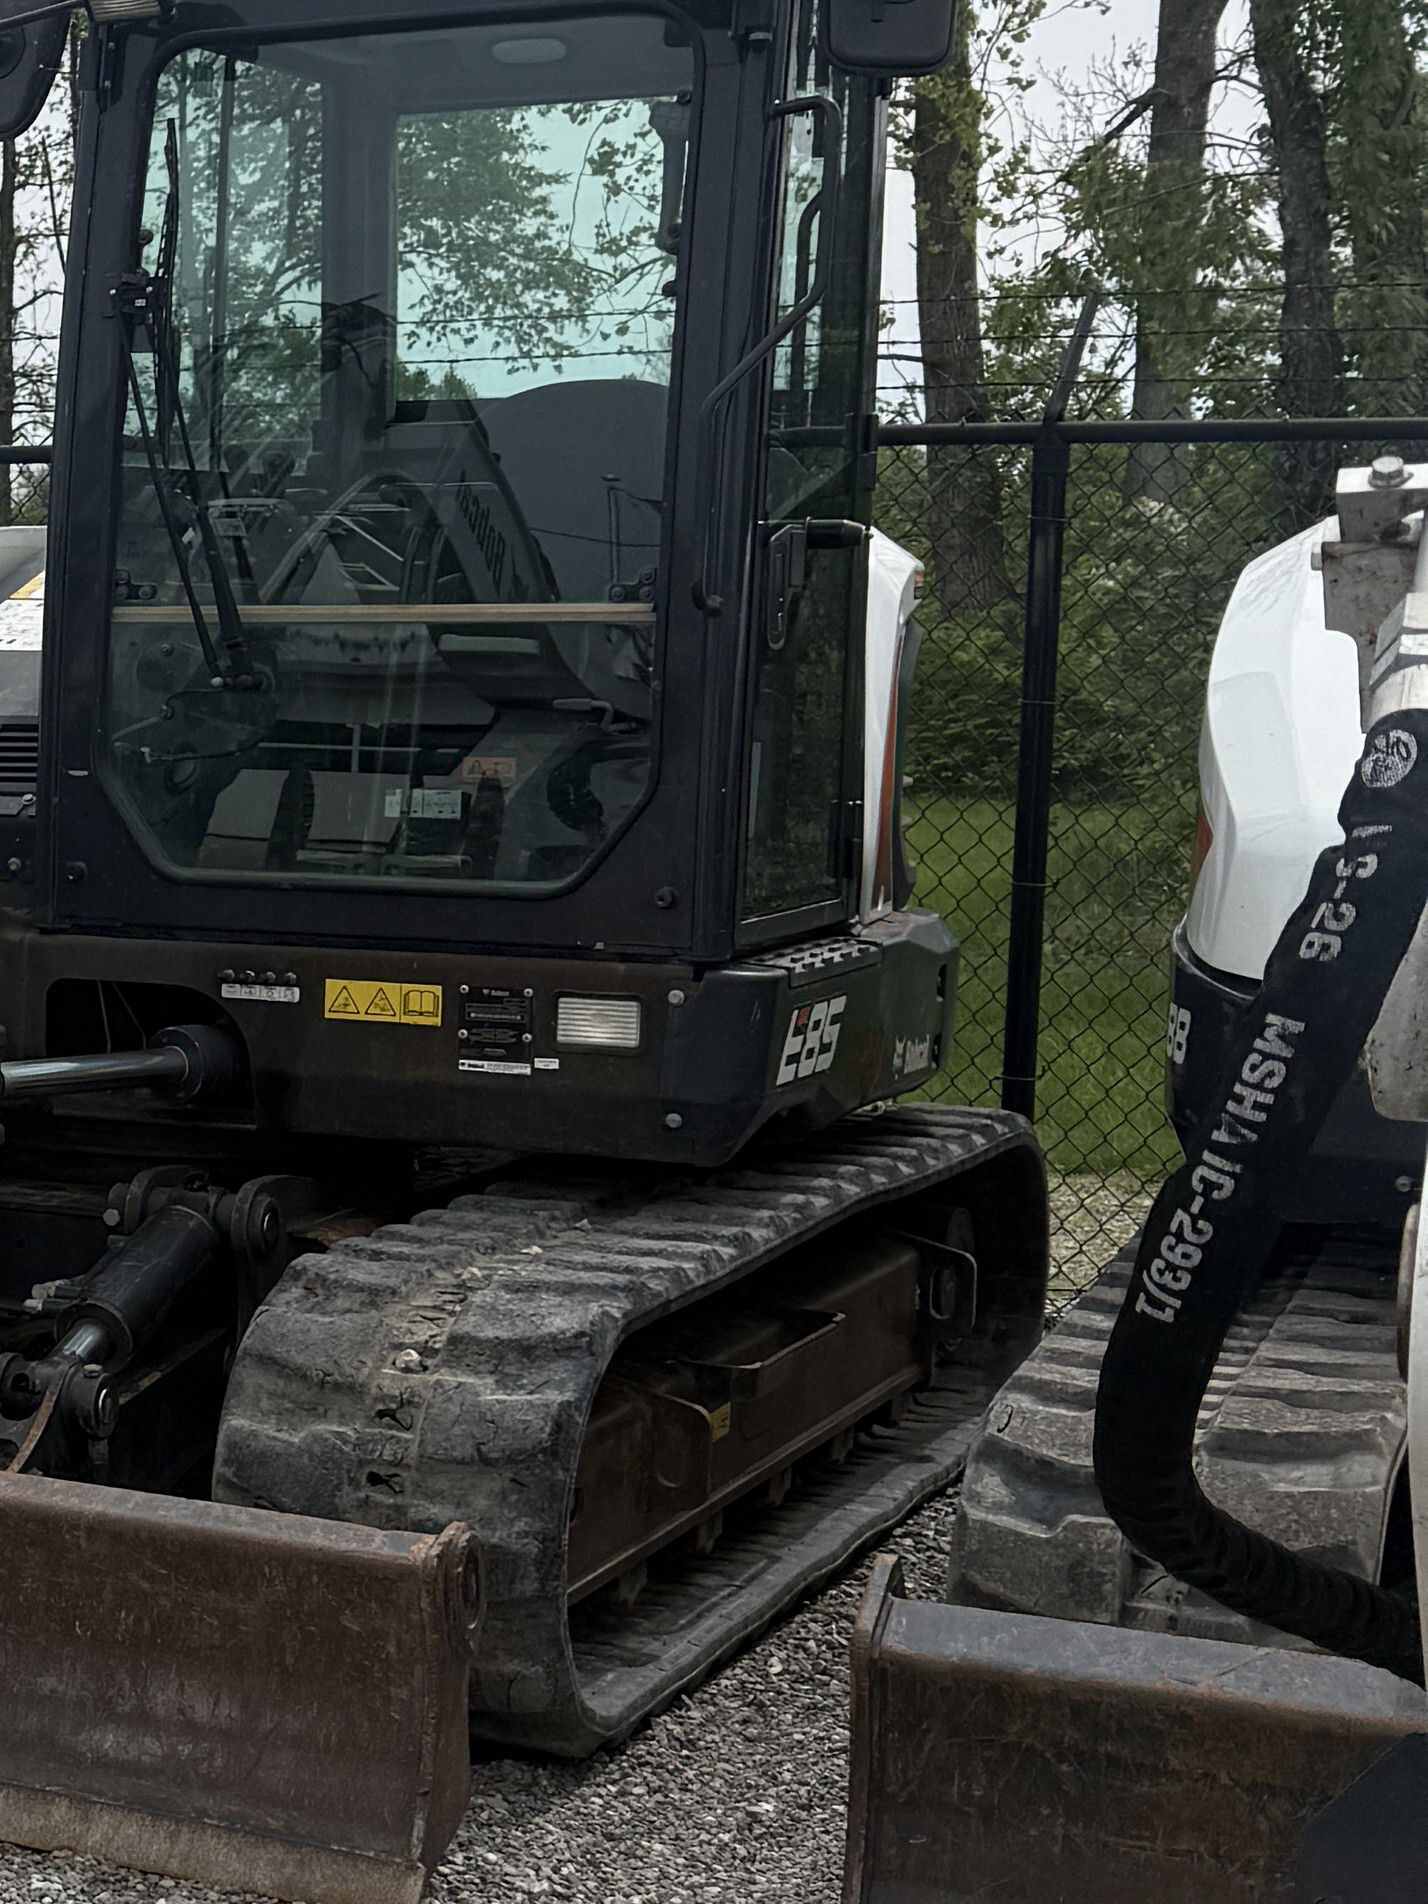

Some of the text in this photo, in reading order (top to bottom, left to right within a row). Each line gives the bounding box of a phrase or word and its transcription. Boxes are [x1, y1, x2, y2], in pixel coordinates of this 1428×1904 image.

[775, 995, 848, 1086] E85
[1210, 1011, 1306, 1146] MSHA
[1135, 1149, 1243, 1324] IC-293/1
